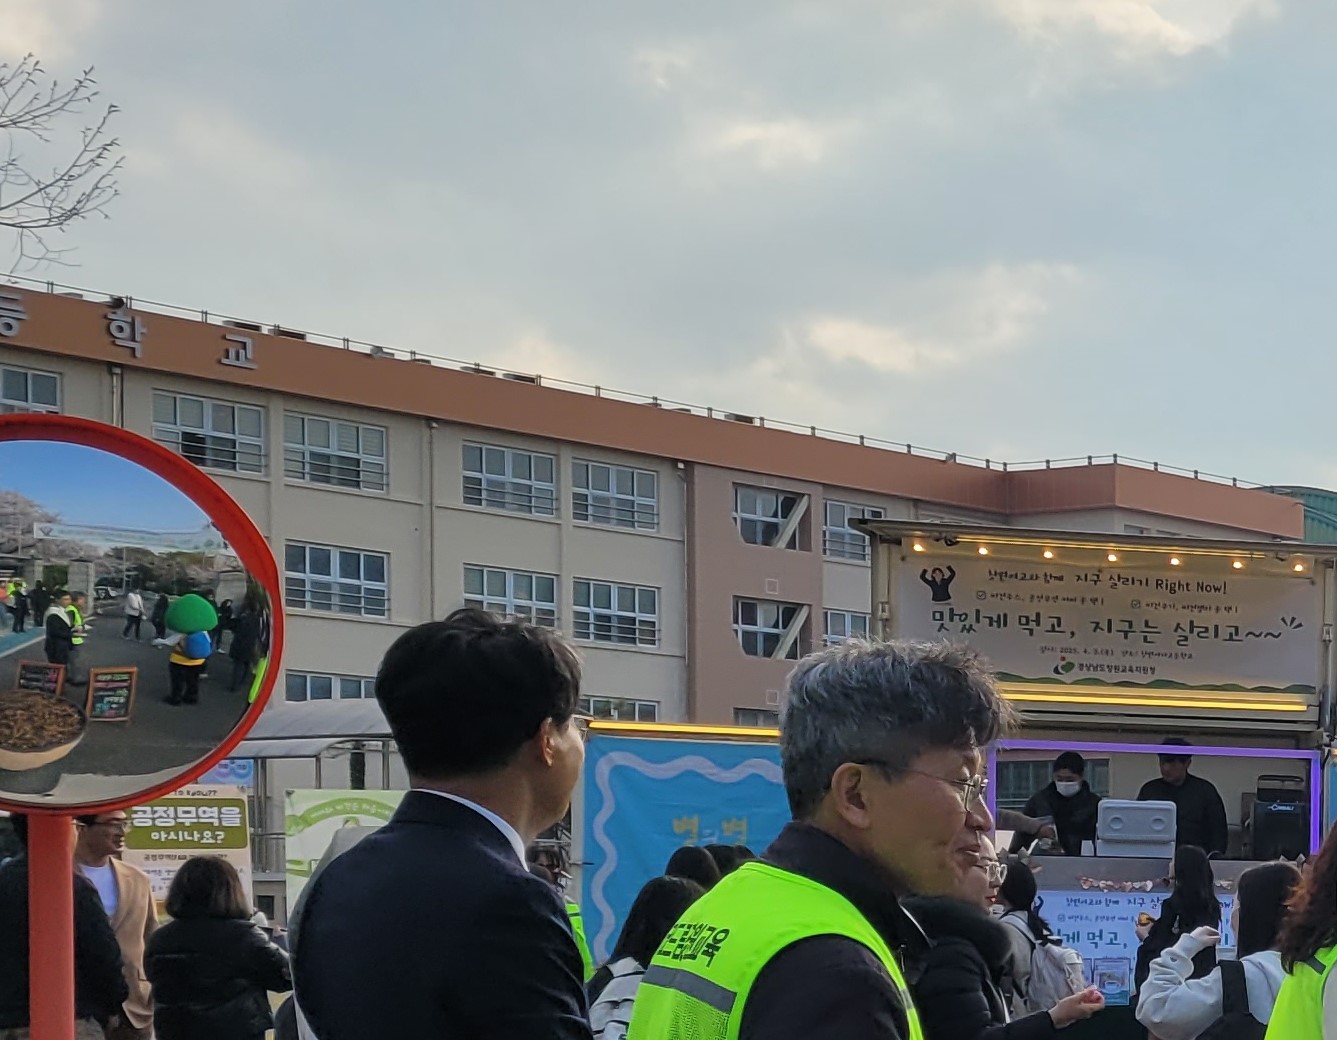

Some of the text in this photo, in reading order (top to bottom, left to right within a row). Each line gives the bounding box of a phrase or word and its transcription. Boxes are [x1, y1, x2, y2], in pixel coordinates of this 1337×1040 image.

[1076, 573, 1102, 586] 지구
[1109, 573, 1149, 589] 살리기
[1155, 578, 1191, 594] Right
[1197, 580, 1227, 595] Now!
[932, 606, 1009, 635] 맛있게
[1017, 612, 1076, 639] 먹고,
[1090, 618, 1162, 644] 지구는
[131, 806, 241, 828] 공정무역을
[151, 831, 225, 844] 아시나요?
[1127, 898, 1146, 908] 지구
[1057, 929, 1128, 949] 게 먹고,
